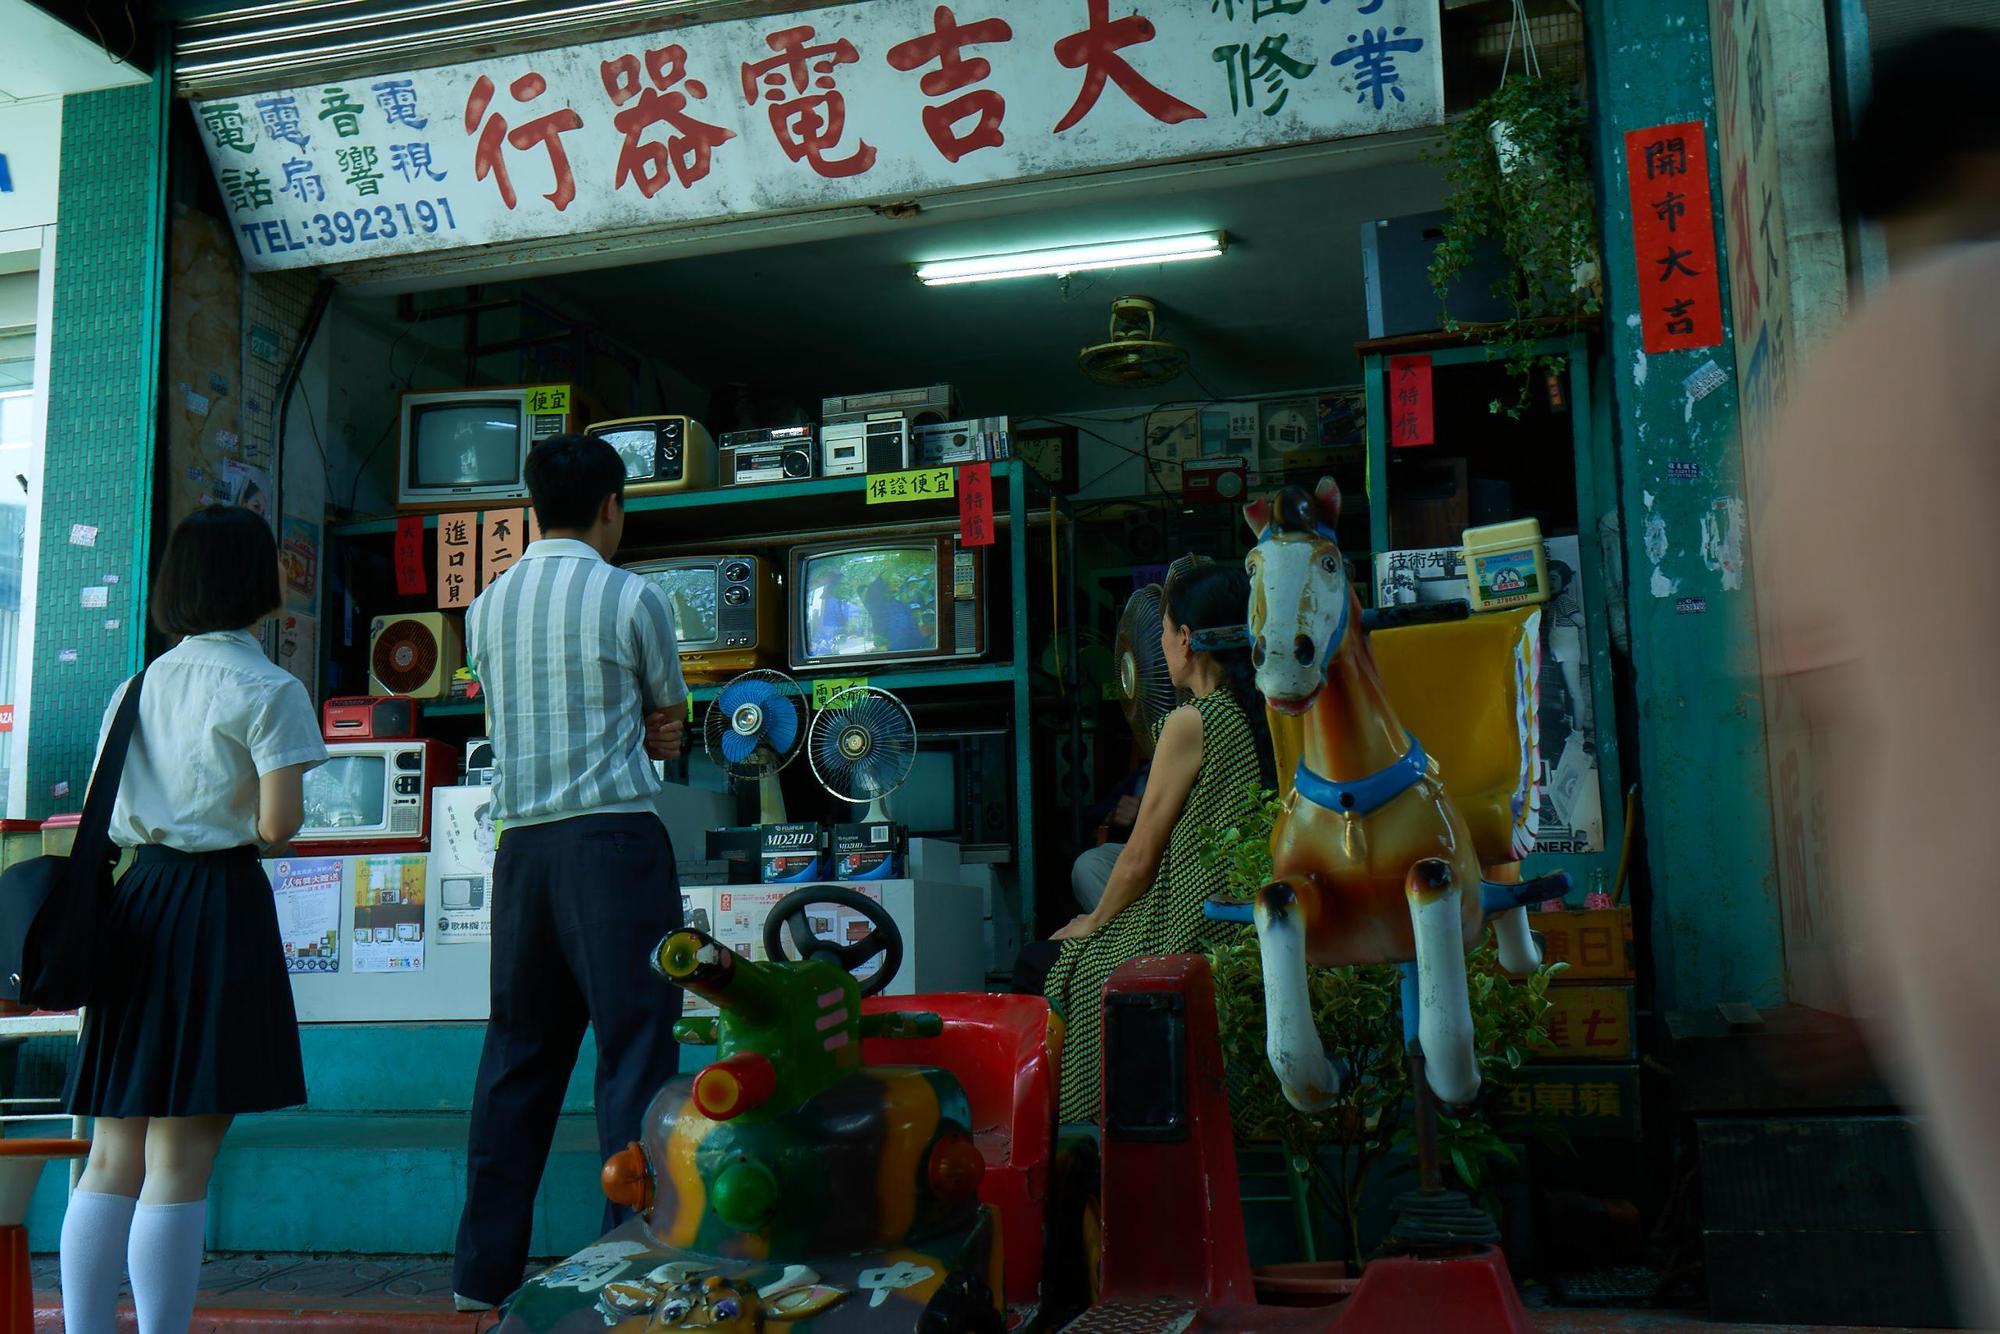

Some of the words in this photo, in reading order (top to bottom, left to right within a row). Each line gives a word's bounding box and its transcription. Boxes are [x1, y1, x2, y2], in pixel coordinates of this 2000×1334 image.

[200, 102, 274, 213] 電話
[255, 96, 325, 204] 電扇
[318, 87, 385, 196] 音響
[371, 79, 448, 183] 電視
[240, 197, 456, 256] TEL:3923191
[1643, 136, 1700, 337] 開市大吉
[530, 389, 566, 411] 便宜
[869, 471, 950, 498] 保證便宜
[444, 521, 469, 604] 進口貨
[488, 518, 512, 585] 不二
[765, 833, 815, 847] MD2HD
